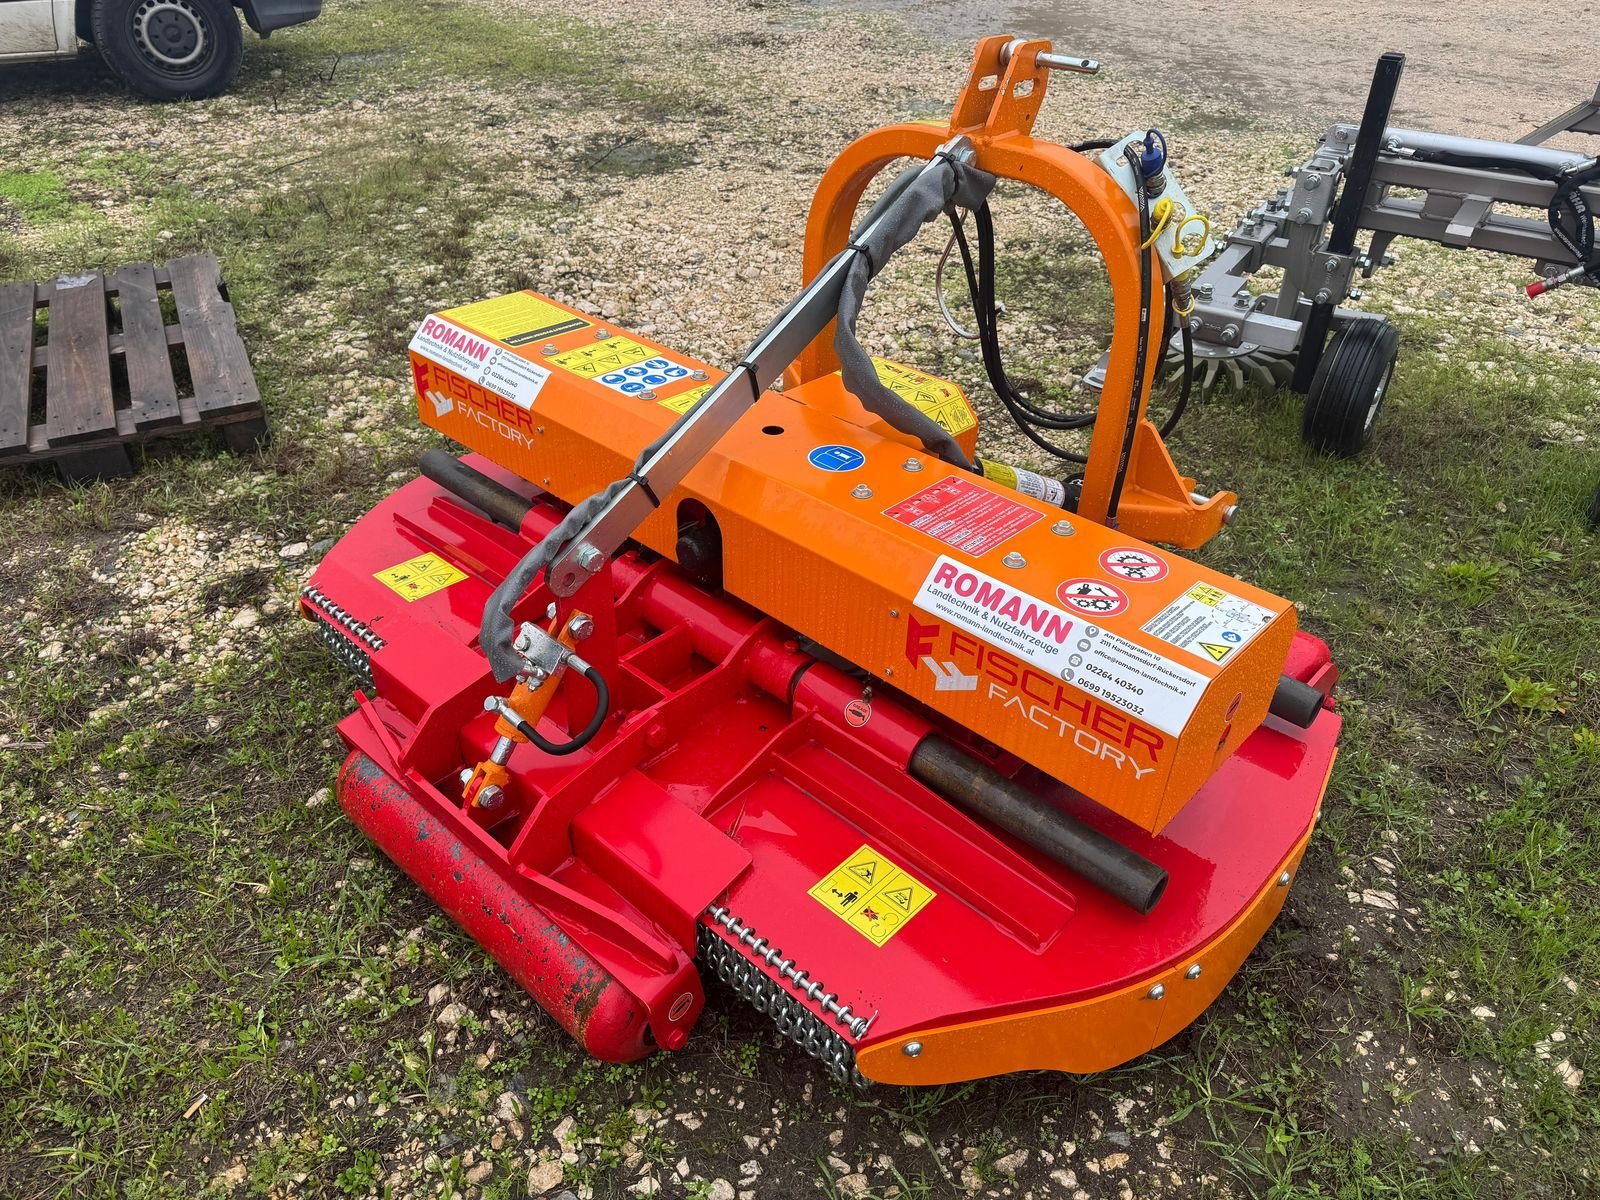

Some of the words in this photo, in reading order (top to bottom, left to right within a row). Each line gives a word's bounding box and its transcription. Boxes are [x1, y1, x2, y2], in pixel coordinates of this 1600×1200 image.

[422, 319, 490, 362] ROMANN
[433, 366, 533, 434] FISCHER
[457, 400, 534, 450] FACTORY
[926, 584, 980, 617] Landtechnik
[980, 611, 989, 621] &
[988, 614, 1059, 655] Nutzfahrzeuge
[933, 562, 1074, 644] ROMANN
[935, 602, 1035, 656] www.romann-landtechnik.at
[1115, 636, 1153, 659] Platzgraben
[1153, 654, 1161, 662] 10
[1085, 663, 1113, 681] 02264
[1114, 677, 1144, 696] 40340
[1094, 649, 1187, 697] office@romann-landtechnik.at
[1099, 639, 1111, 649] 2111
[1111, 644, 1197, 688] Harmannsdorf-Rückersdorf
[949, 631, 1165, 763] FISCHER
[1077, 677, 1100, 693] 0699
[1101, 687, 1145, 715] 19523032
[987, 682, 1156, 780] FACTORY
